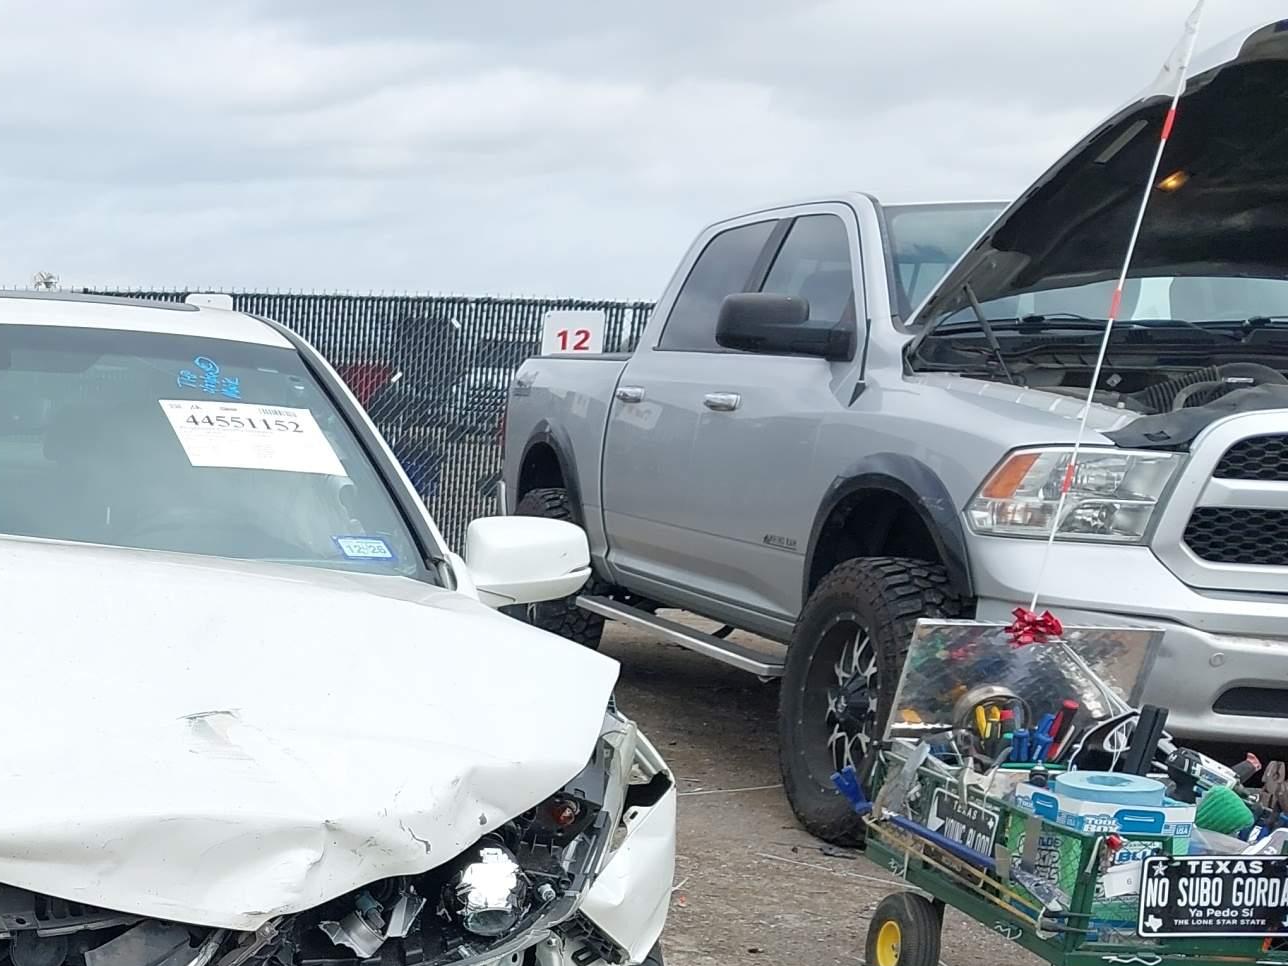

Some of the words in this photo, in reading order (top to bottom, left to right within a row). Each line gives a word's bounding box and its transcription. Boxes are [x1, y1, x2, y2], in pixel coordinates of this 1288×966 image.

[556, 329, 591, 351] 12
[186, 413, 304, 434] 44551152
[1176, 826, 1189, 835] USA
[1187, 861, 1263, 874] TEXAS
[1146, 878, 1170, 908] NO
[1177, 878, 1223, 908] SUBO
[1189, 908, 1203, 918] Ya
[1206, 908, 1239, 918] Pedo
